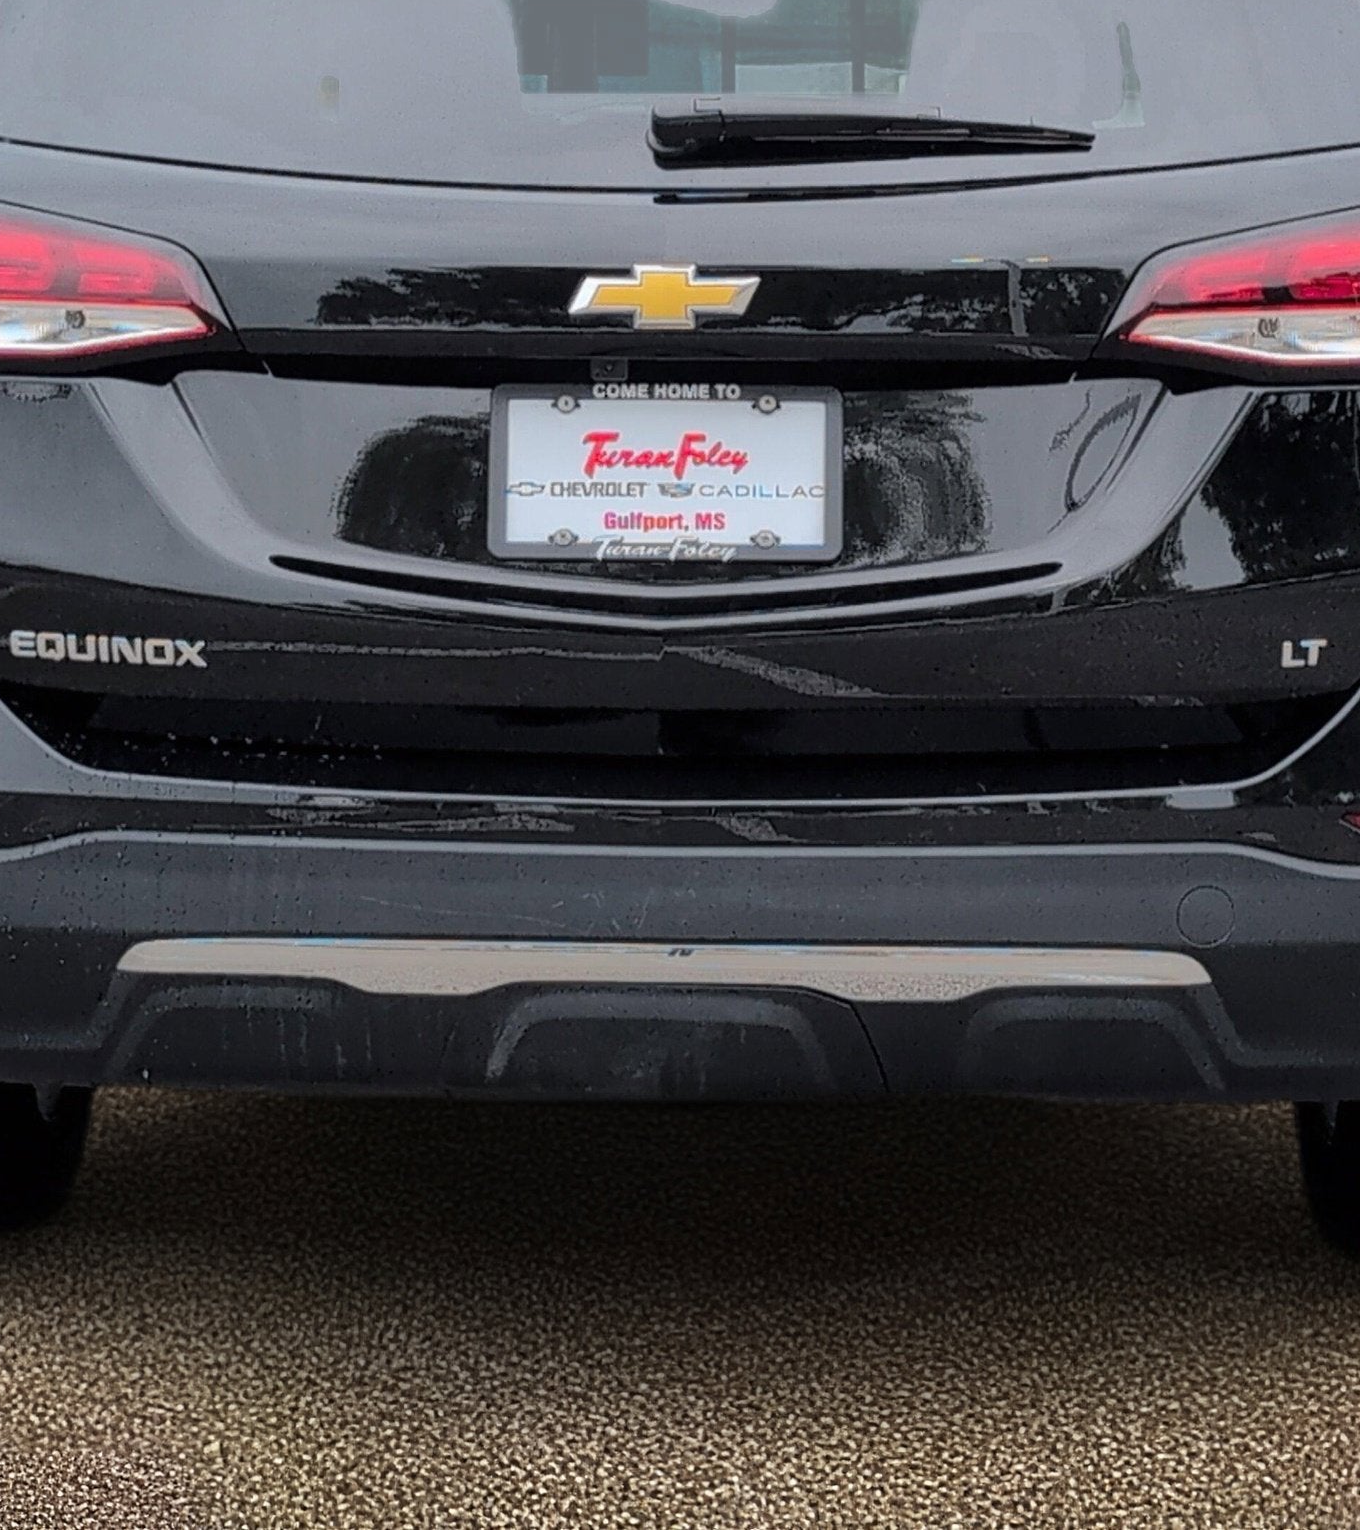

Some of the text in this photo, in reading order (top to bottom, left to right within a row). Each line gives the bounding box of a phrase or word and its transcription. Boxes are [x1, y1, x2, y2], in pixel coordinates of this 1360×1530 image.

[593, 383, 741, 400] COME HOME TO
[550, 482, 825, 498] CHEVROLET CADILLAC
[604, 511, 726, 532] Gulfport, MS
[9, 629, 208, 668] EQUINOX
[1281, 638, 1328, 668] LT
